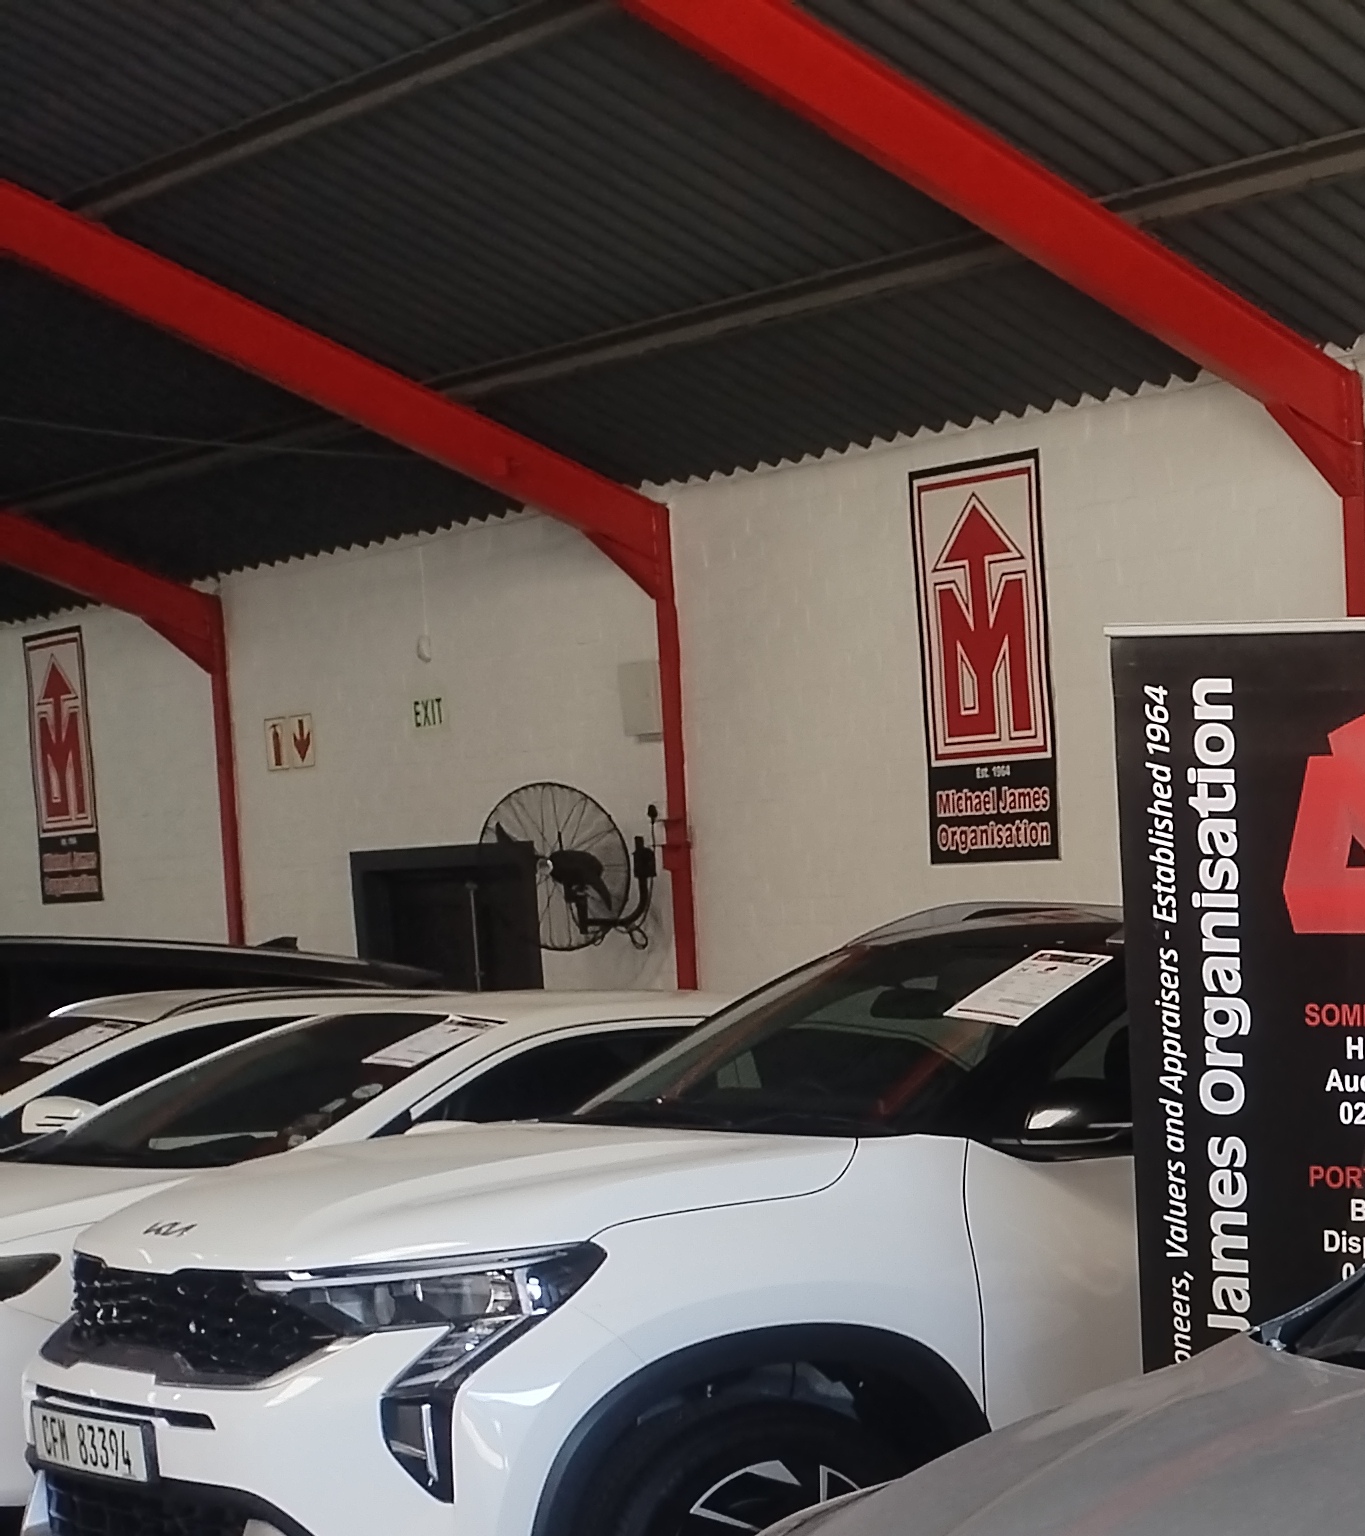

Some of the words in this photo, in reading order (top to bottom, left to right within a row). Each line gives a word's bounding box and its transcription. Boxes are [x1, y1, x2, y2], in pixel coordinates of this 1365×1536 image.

[413, 697, 443, 728] EXIT
[1144, 684, 1171, 755] 1964
[936, 787, 997, 818] Michael
[999, 786, 1050, 814] James
[937, 819, 1051, 854] Organisation
[1145, 762, 1178, 924] Established
[1186, 677, 1252, 1116] Organisation
[1154, 947, 1189, 1095] Appraisers
[1158, 1097, 1186, 1153] and
[1163, 1159, 1189, 1258] Valuers
[1207, 1136, 1251, 1332] James
[41, 1415, 70, 1461] CFM
[77, 1423, 132, 1474] 83394
